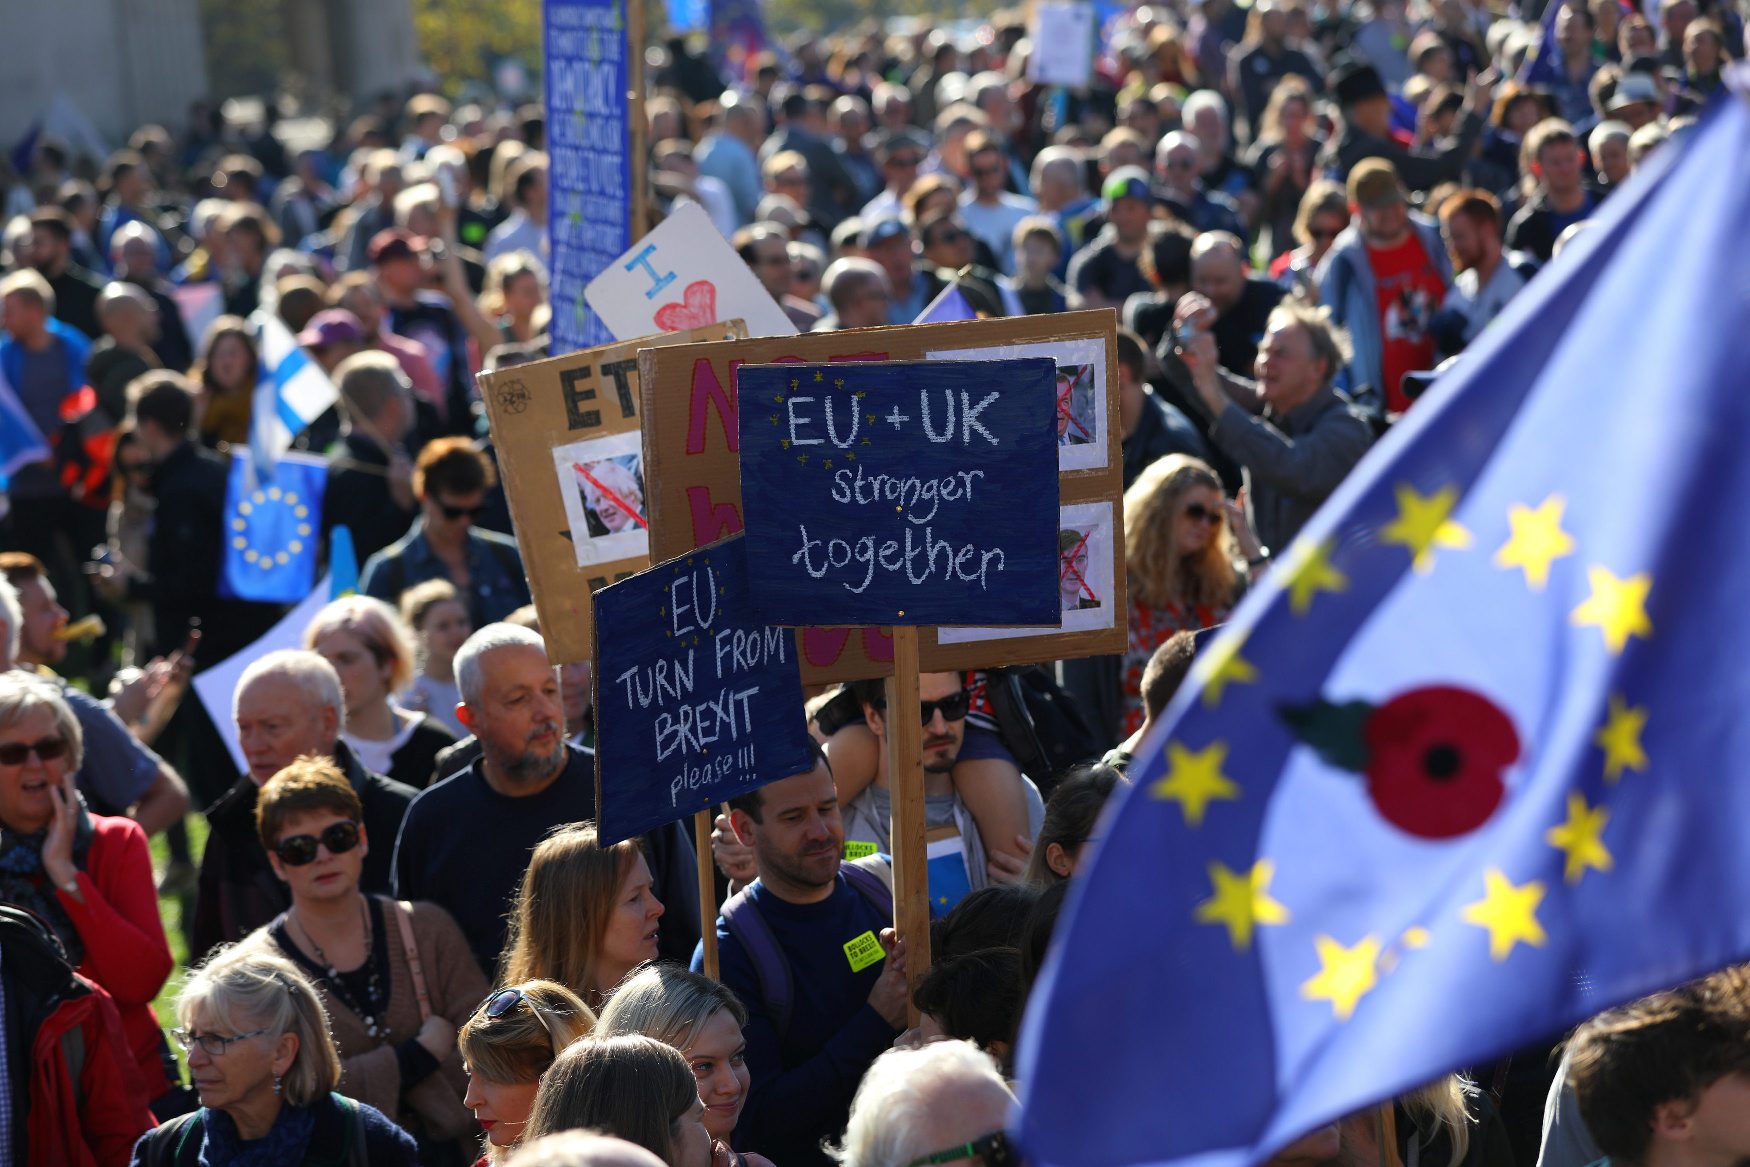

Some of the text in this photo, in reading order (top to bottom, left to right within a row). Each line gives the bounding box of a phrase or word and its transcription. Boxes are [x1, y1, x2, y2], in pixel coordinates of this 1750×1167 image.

[624, 244, 677, 300] I
[788, 395, 859, 448] EU
[885, 405, 910, 430] +
[920, 389, 1000, 446] UK
[792, 524, 1005, 593] together
[671, 567, 716, 636] EU
[616, 648, 694, 709] TURN
[715, 626, 785, 678] FROM
[655, 687, 760, 762] BREXIT
